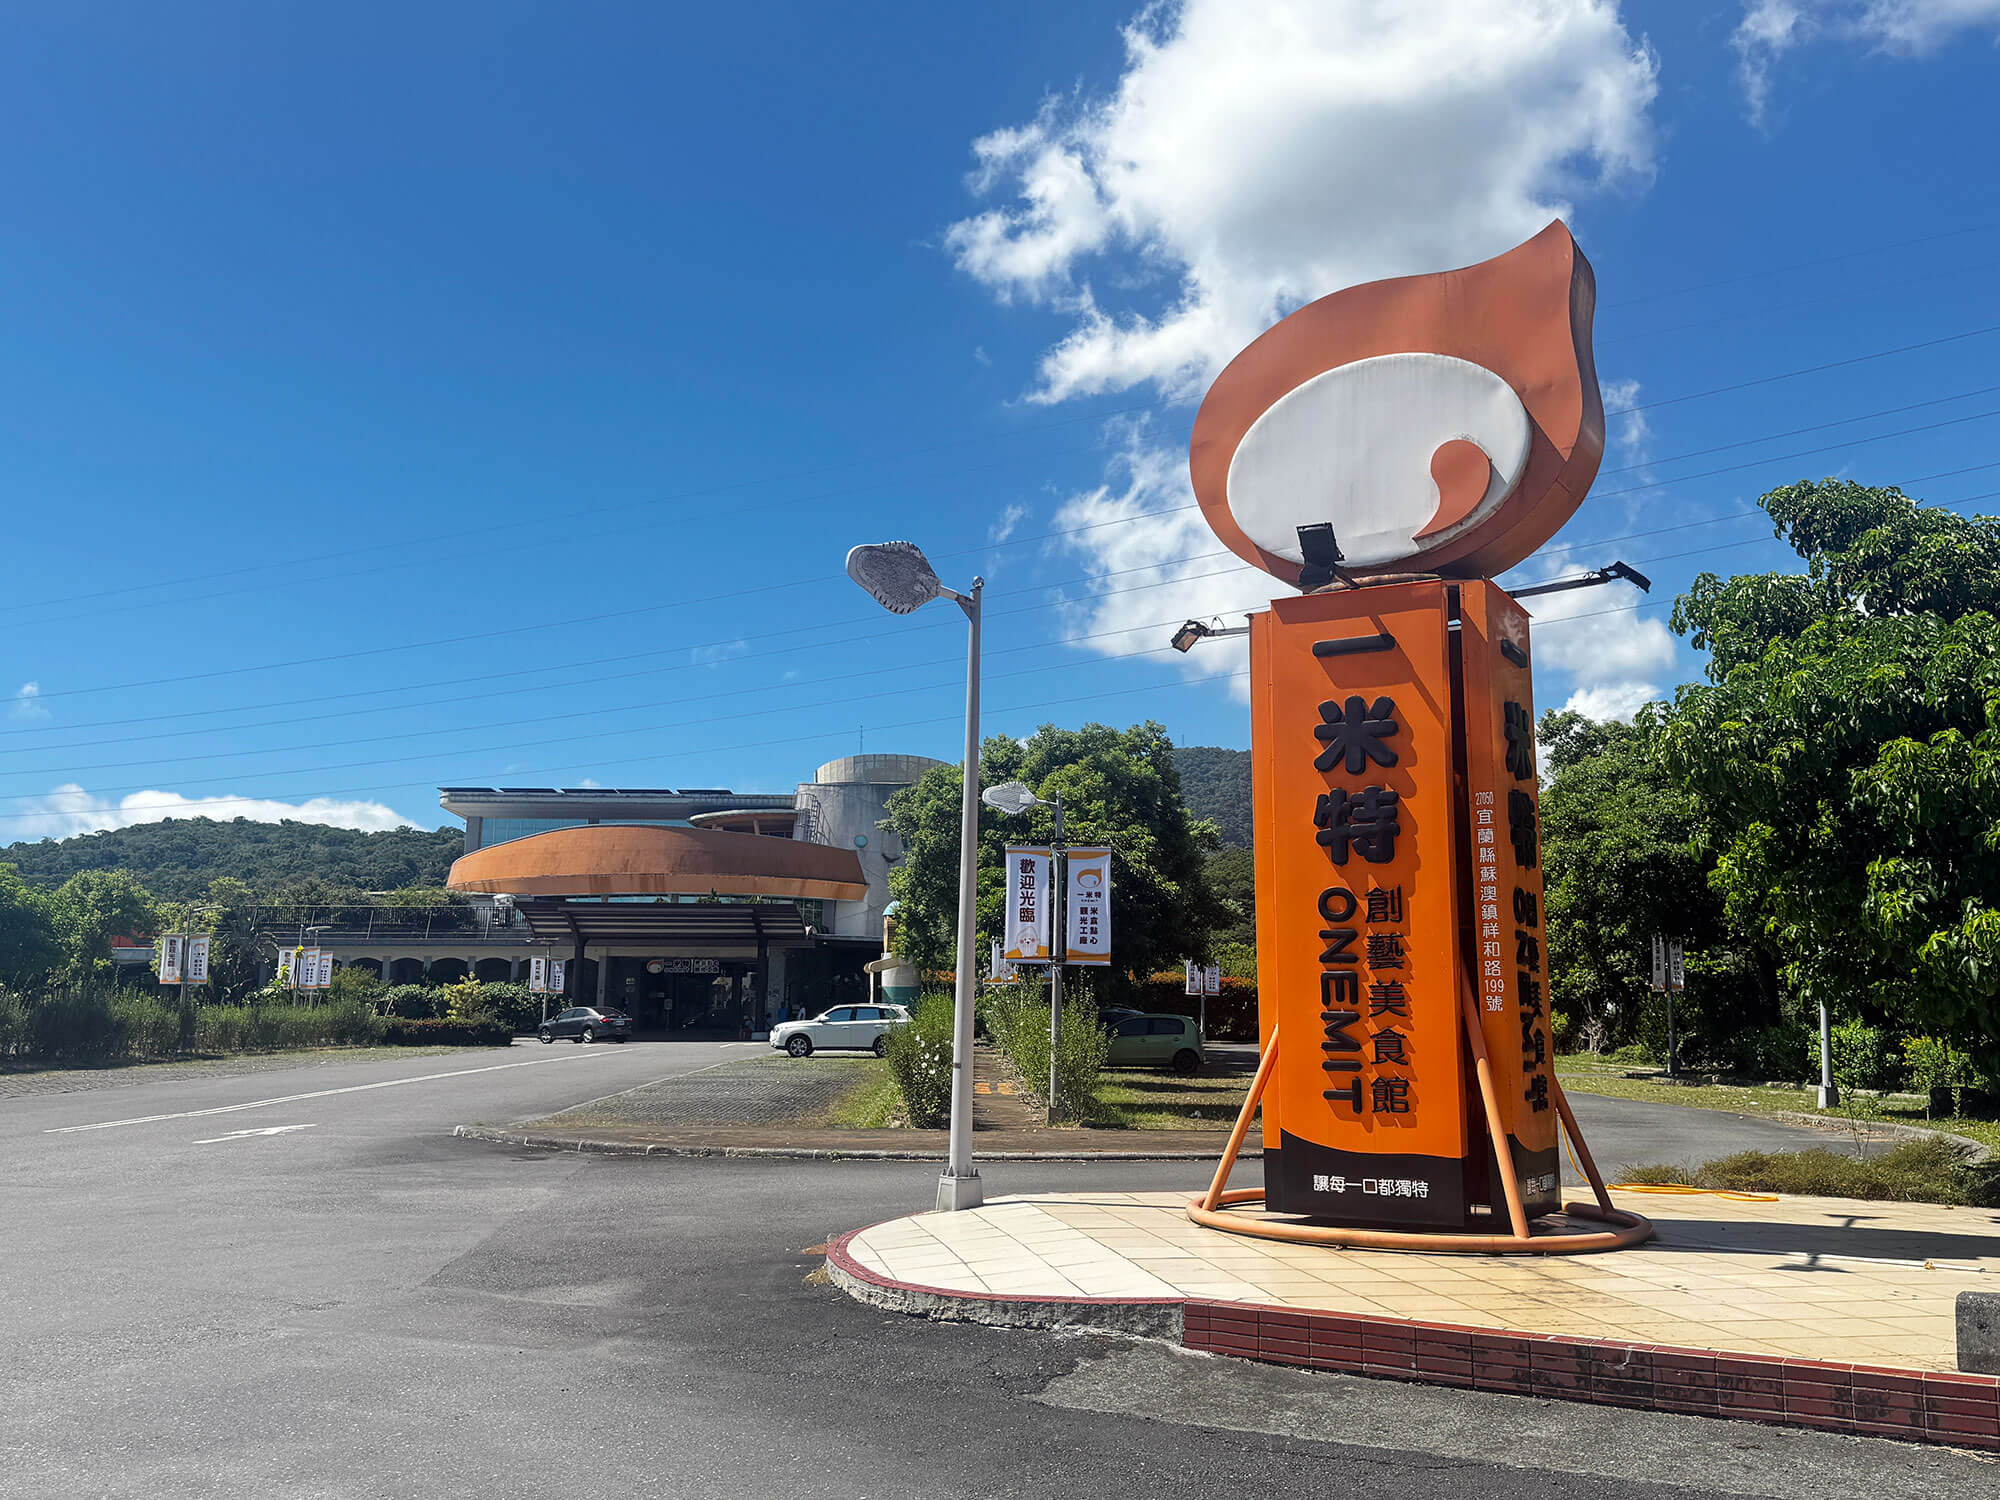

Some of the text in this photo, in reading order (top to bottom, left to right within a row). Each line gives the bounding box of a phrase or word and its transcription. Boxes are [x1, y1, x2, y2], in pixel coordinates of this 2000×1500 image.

[1312, 632, 1401, 867] 一米特
[1019, 858, 1036, 923] 歡迎光臨
[1317, 886, 1364, 1115] ONEMIT
[1365, 885, 1411, 1115] 創藝美食館
[1312, 1174, 1430, 1199] 讓每一口都獨特
